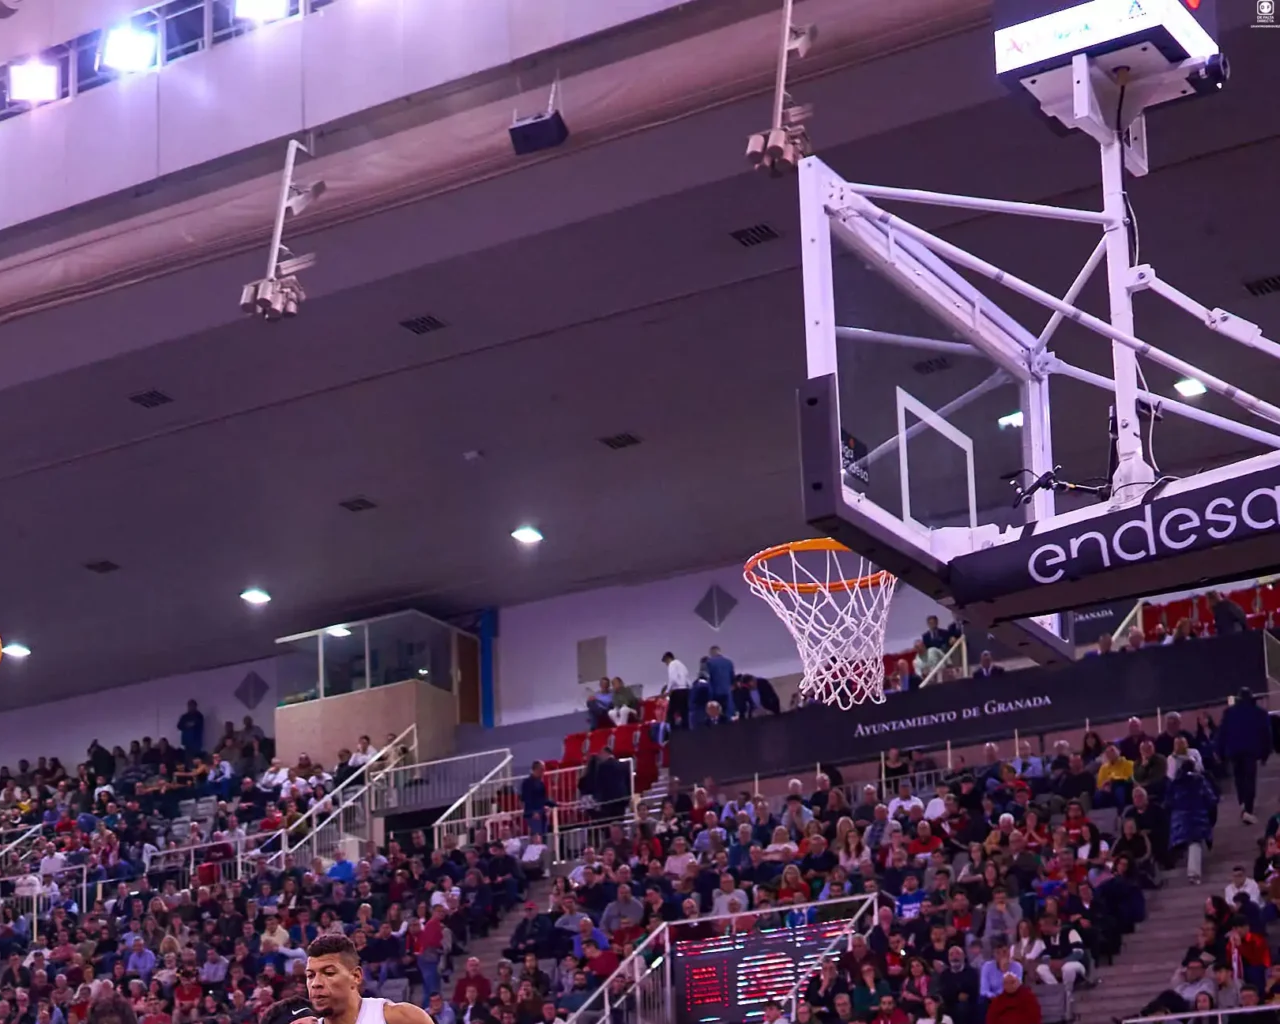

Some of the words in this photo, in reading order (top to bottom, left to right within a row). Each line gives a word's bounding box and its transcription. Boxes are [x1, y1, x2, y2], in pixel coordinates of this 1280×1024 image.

[1028, 487, 1280, 584] endesa
[853, 711, 957, 738] AYUNTAMIENTO
[962, 706, 981, 719] DE
[984, 695, 1052, 715] GRANADA
